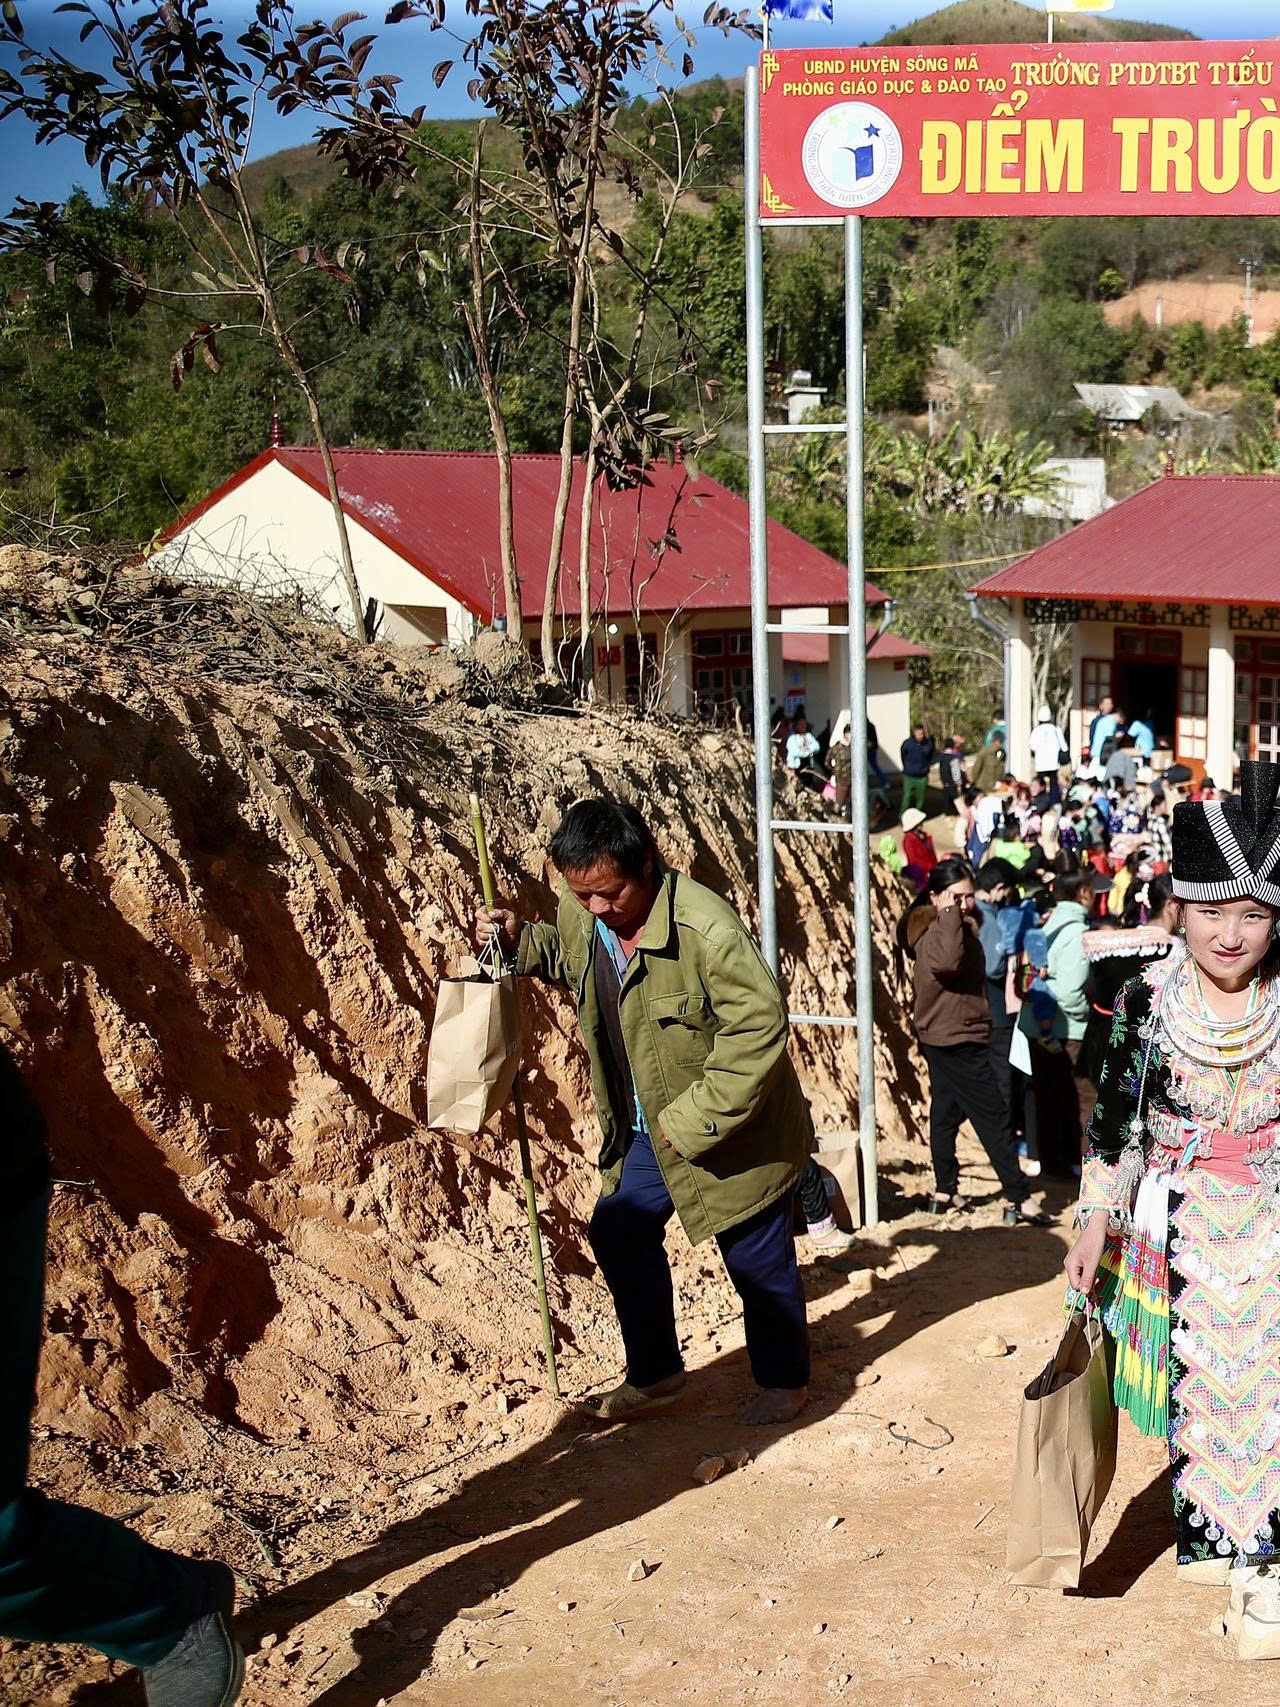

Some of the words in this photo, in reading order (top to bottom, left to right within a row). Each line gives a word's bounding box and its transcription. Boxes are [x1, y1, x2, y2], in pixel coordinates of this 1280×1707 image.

[803, 59, 846, 75] UBND
[850, 55, 900, 76] HUYỆN
[905, 54, 949, 73] SÔNG
[954, 52, 980, 72] MÃ
[1108, 60, 1201, 86] PTDTBT
[783, 78, 835, 97] PHÒNG
[840, 76, 878, 96] GIÁO
[883, 79, 915, 98] DỤC
[920, 78, 933, 93] &
[937, 75, 971, 93] ĐÀO
[975, 77, 1007, 96] TẠO
[919, 88, 1085, 194] ĐIỂM
